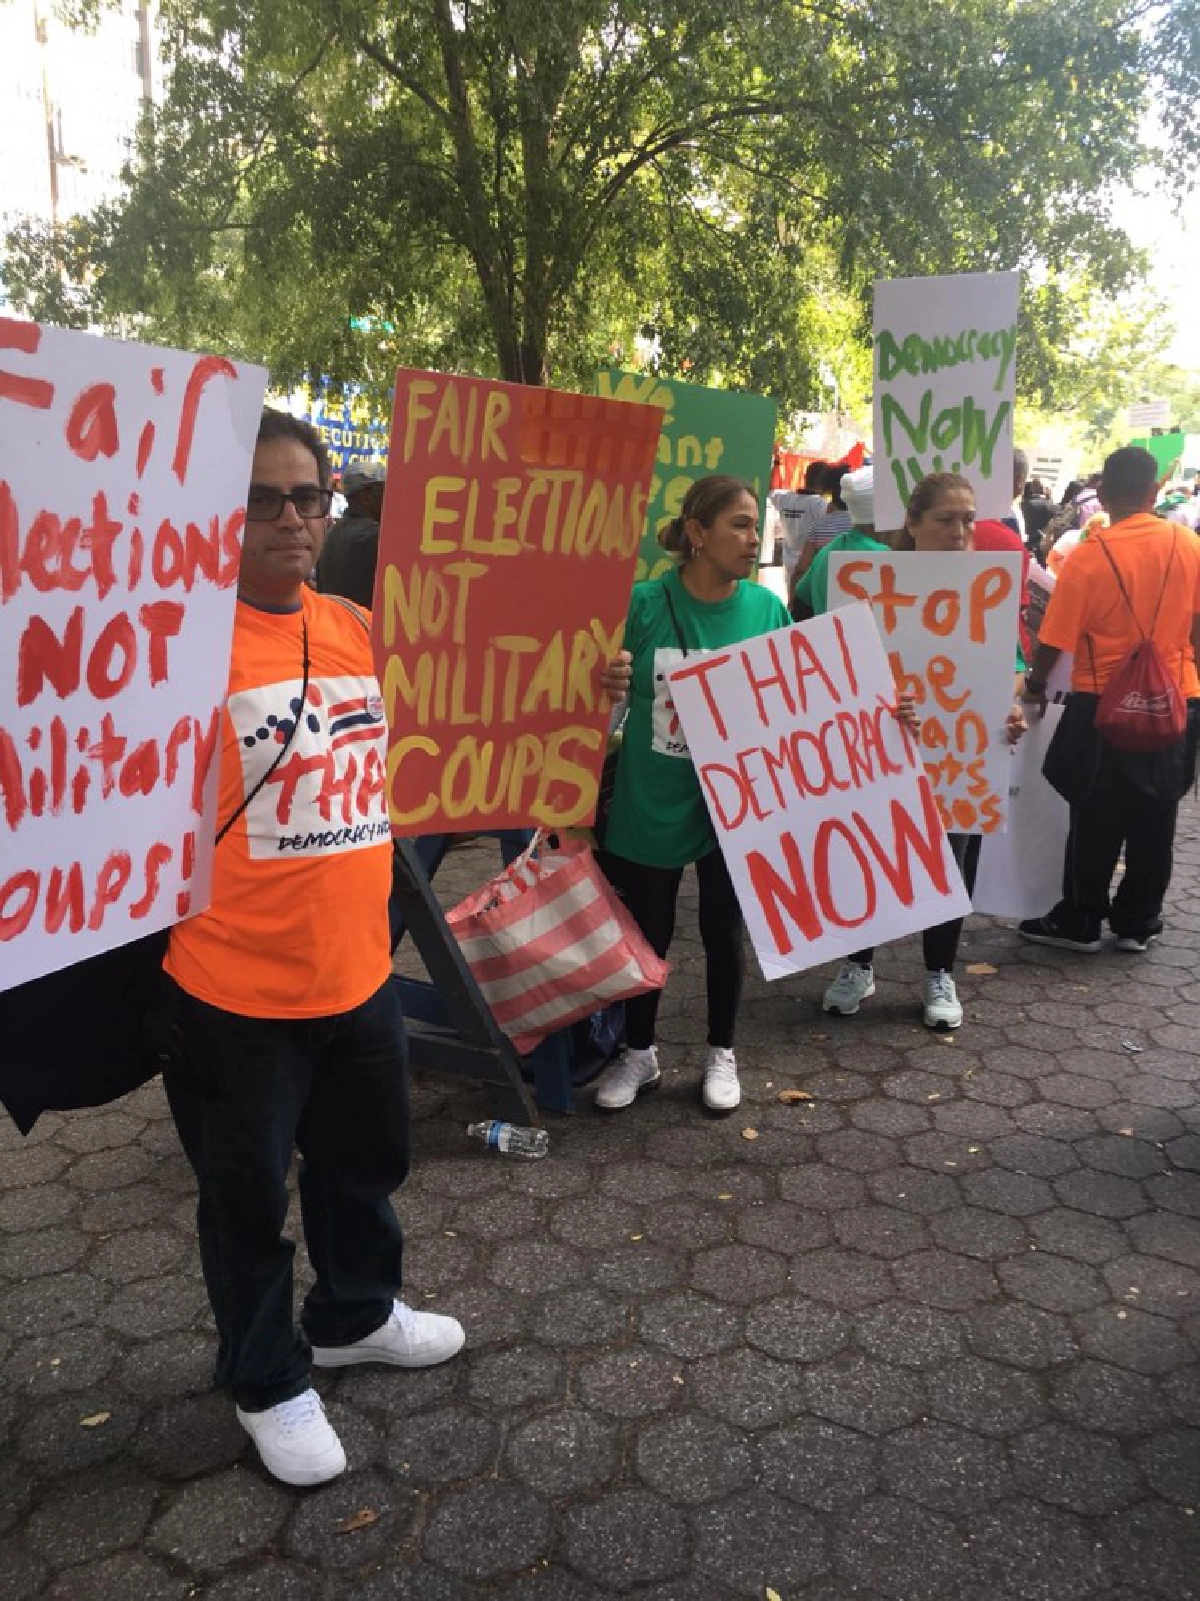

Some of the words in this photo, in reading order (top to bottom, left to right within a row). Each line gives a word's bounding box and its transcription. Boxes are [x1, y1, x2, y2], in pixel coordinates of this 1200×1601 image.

[403, 380, 511, 465] FAIR
[0, 481, 247, 606] lections
[420, 468, 649, 561] ELECTIONS
[17, 601, 186, 708] NOT
[383, 559, 490, 648] NOT
[383, 618, 627, 730] MILITARY
[669, 615, 858, 742] THAI
[0, 704, 219, 833] ilitary
[387, 725, 603, 828] COUPS
[0, 832, 196, 942] oups!
[278, 823, 376, 851] DEMOCRACY
[745, 775, 953, 955] NOW
